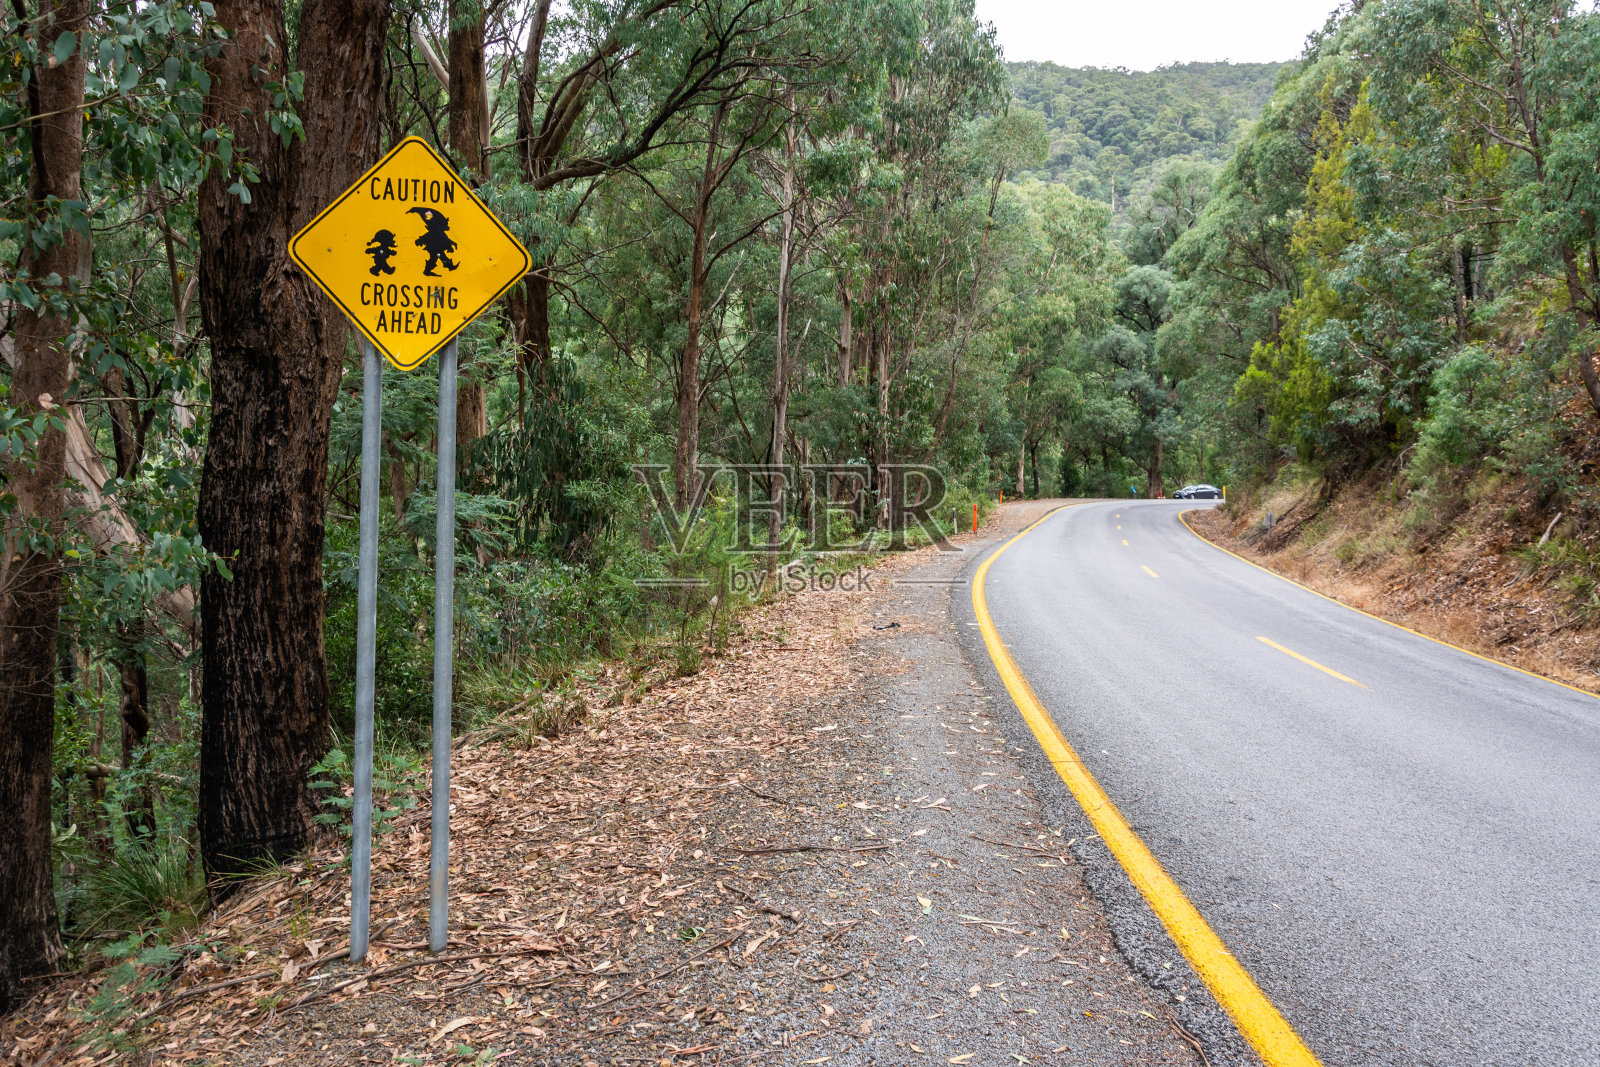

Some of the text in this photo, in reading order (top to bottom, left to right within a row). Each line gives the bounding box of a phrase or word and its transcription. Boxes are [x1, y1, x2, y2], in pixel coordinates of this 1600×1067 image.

[370, 177, 455, 203] CAUTION
[360, 282, 458, 310] CROSSING
[375, 310, 441, 334] AHEAD
